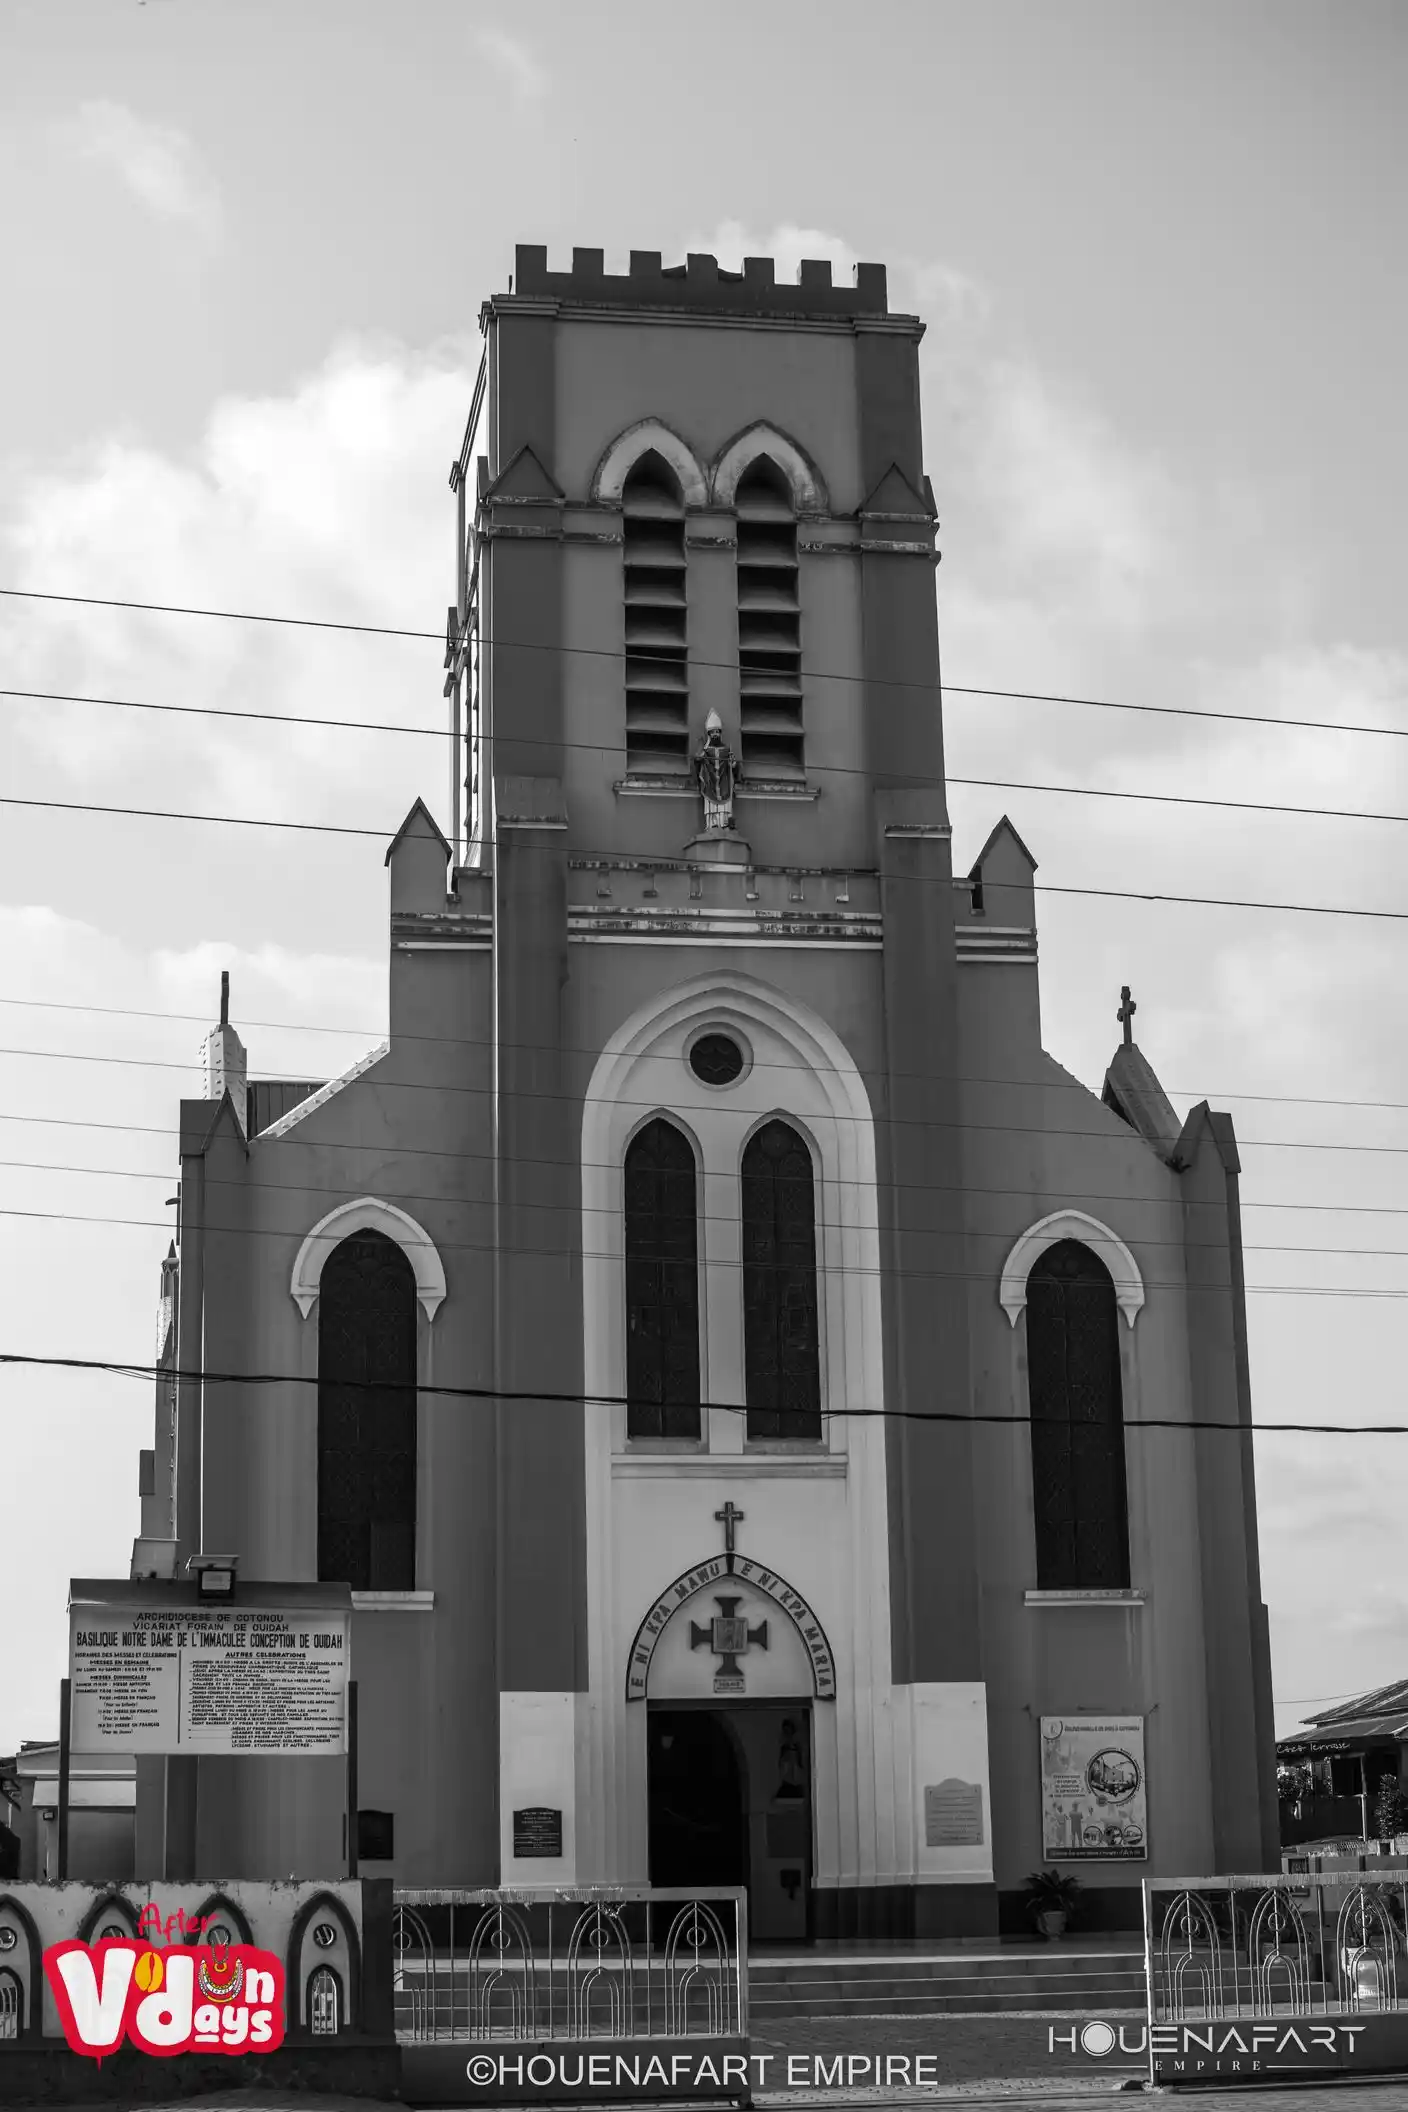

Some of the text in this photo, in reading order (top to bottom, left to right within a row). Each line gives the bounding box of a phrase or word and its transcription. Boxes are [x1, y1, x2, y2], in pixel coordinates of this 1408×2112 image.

[137, 1613, 212, 1622] ARCHIDIOCESE
[236, 1613, 284, 1622] COTONOU
[631, 1563, 720, 1688] E NI KPA MAWU
[740, 1562, 832, 1687] E NI KPA MARIA
[133, 1623, 289, 1631] VICARIAT FORAIN DE OUIDAH
[77, 1631, 343, 1649] BASILIQUE NOTRE DAME DE L'IMMACULEE CONCEPTION DE OUIDAH
